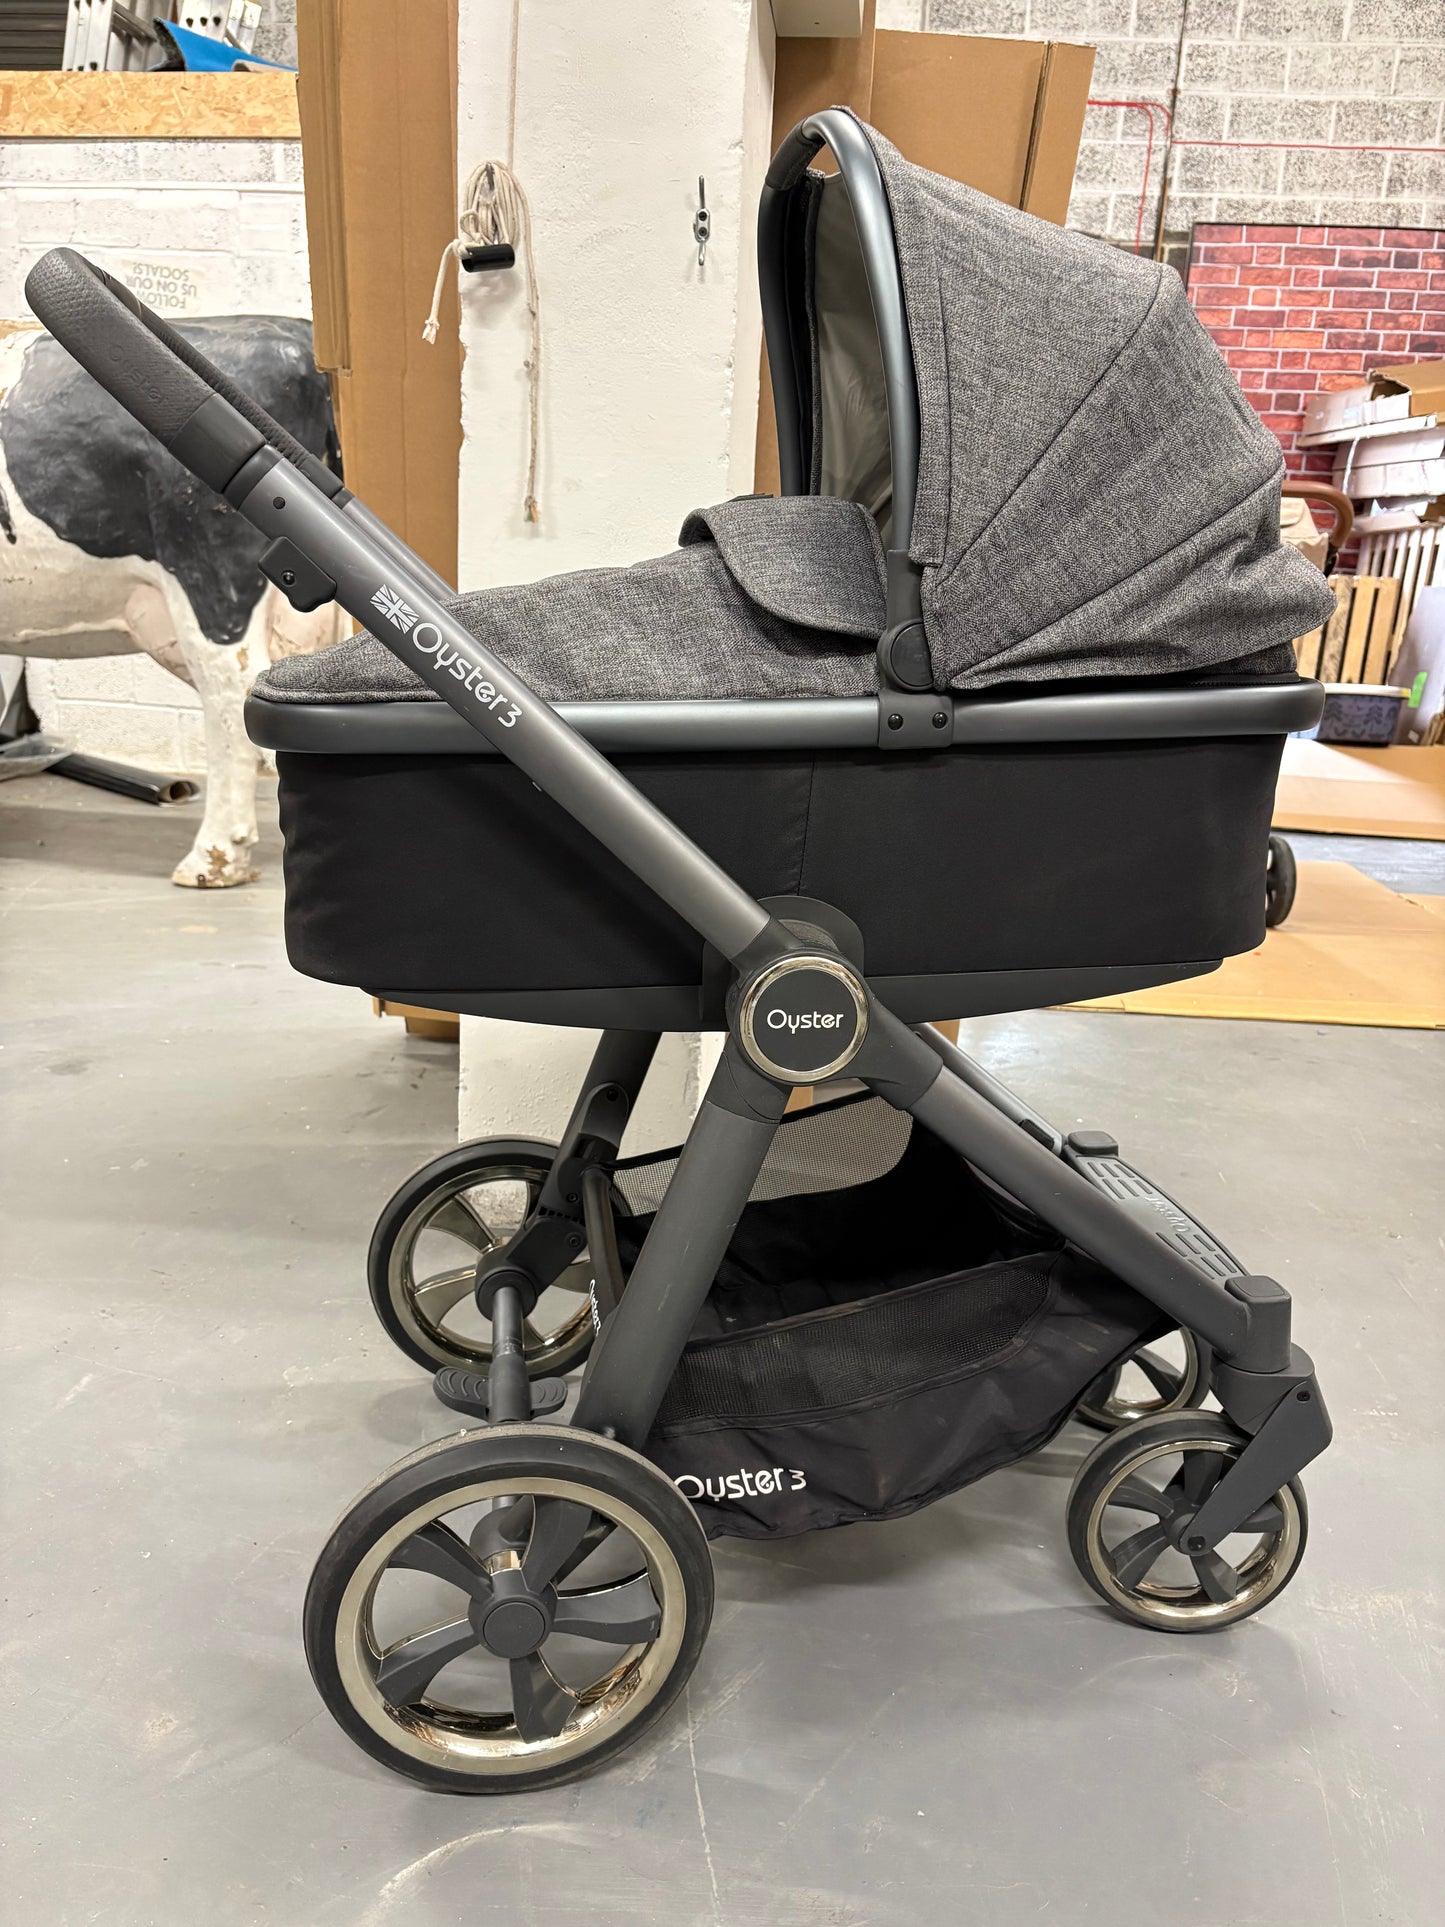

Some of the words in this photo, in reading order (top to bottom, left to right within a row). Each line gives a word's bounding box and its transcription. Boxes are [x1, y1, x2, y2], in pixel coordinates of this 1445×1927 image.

[157, 280, 178, 293] ON
[182, 283, 197, 297] US
[412, 622, 508, 711] Oyster
[497, 703, 523, 728] 3
[766, 1009, 844, 1034] Oyster
[673, 1468, 784, 1502] Oyster
[788, 1469, 807, 1491] 3
